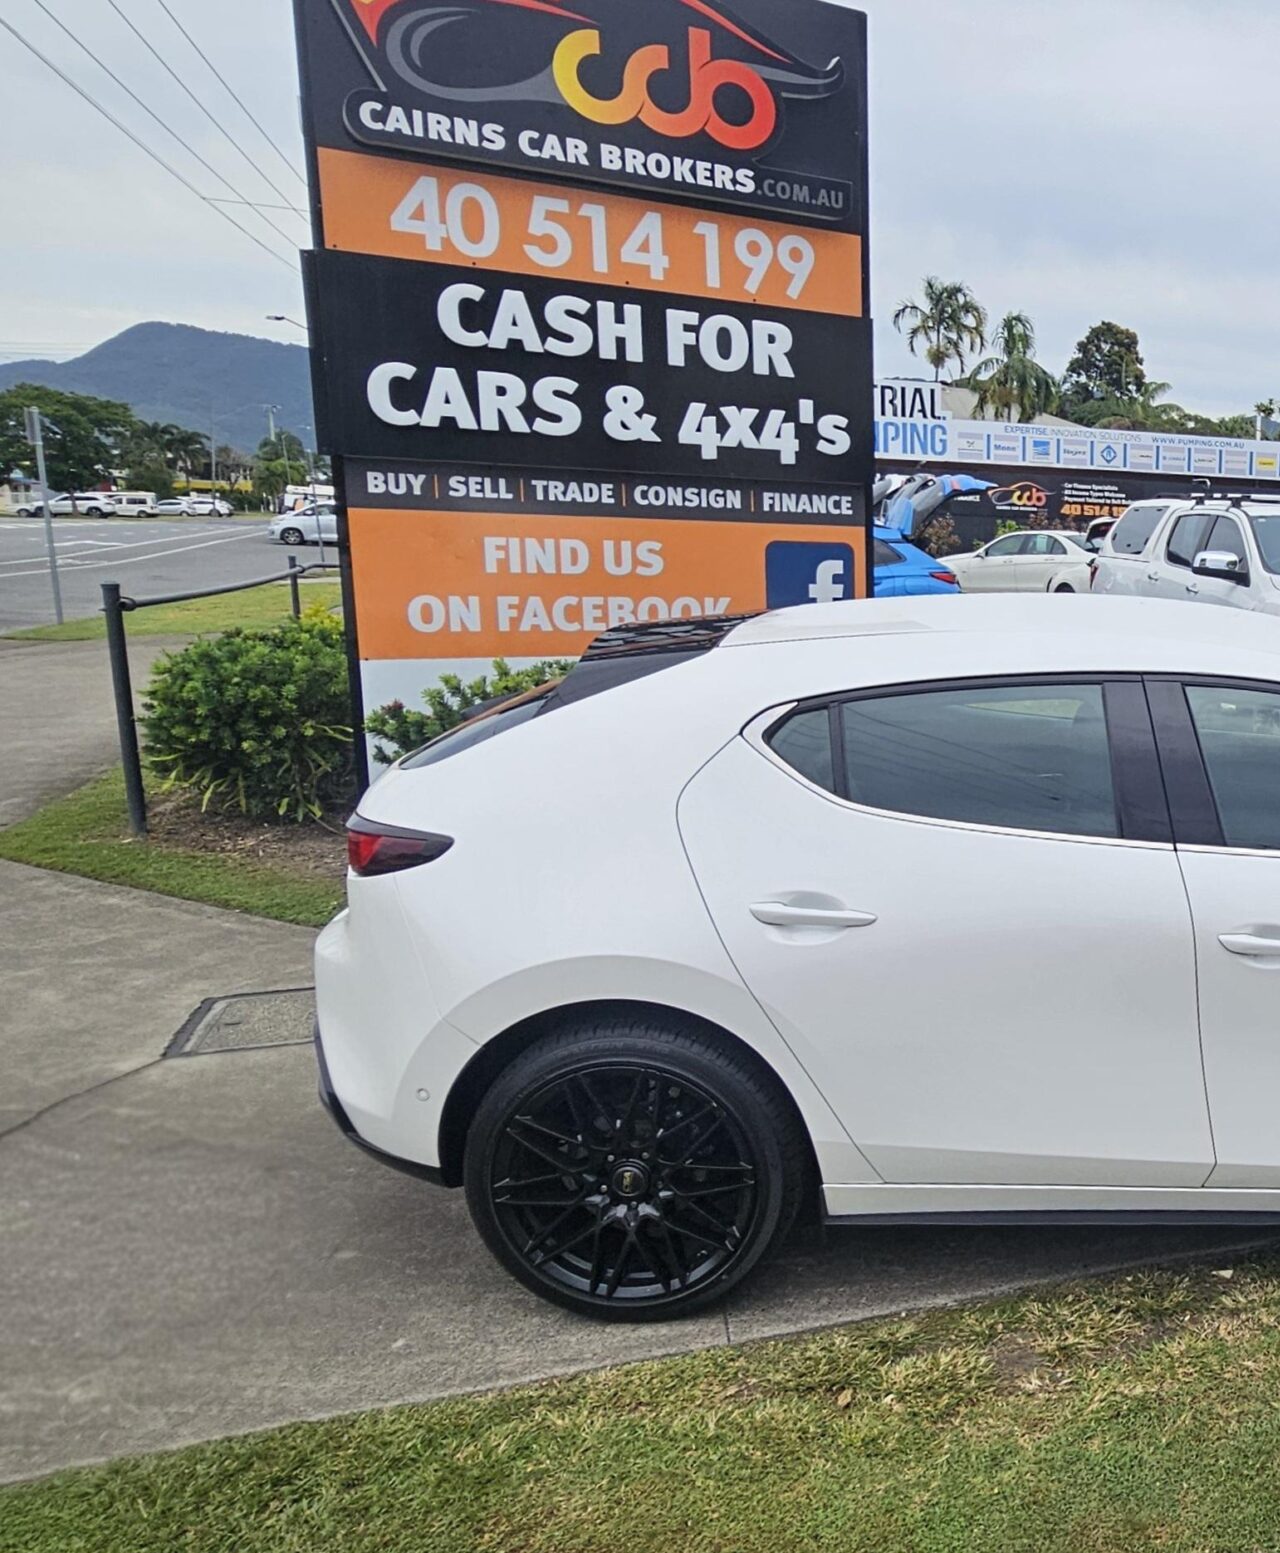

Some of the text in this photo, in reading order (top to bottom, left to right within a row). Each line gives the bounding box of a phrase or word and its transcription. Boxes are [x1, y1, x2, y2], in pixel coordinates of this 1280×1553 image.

[359, 101, 506, 150] CAIRNS
[518, 130, 590, 166] CAR
[390, 176, 815, 300] 40 514 199
[437, 283, 795, 378] CASH FOR
[367, 362, 582, 436] CARS
[603, 385, 661, 443] &
[873, 384, 947, 421] RIAL.
[1152, 436, 1245, 449] WWW.PUMPING.COM.AU
[366, 471, 853, 515] BUY SELL TRADE CONSIGN FINANCE
[1060, 503, 1081, 515] 40
[1083, 504, 1110, 517] 514
[484, 536, 664, 576] FIND US
[408, 594, 482, 633] ON
